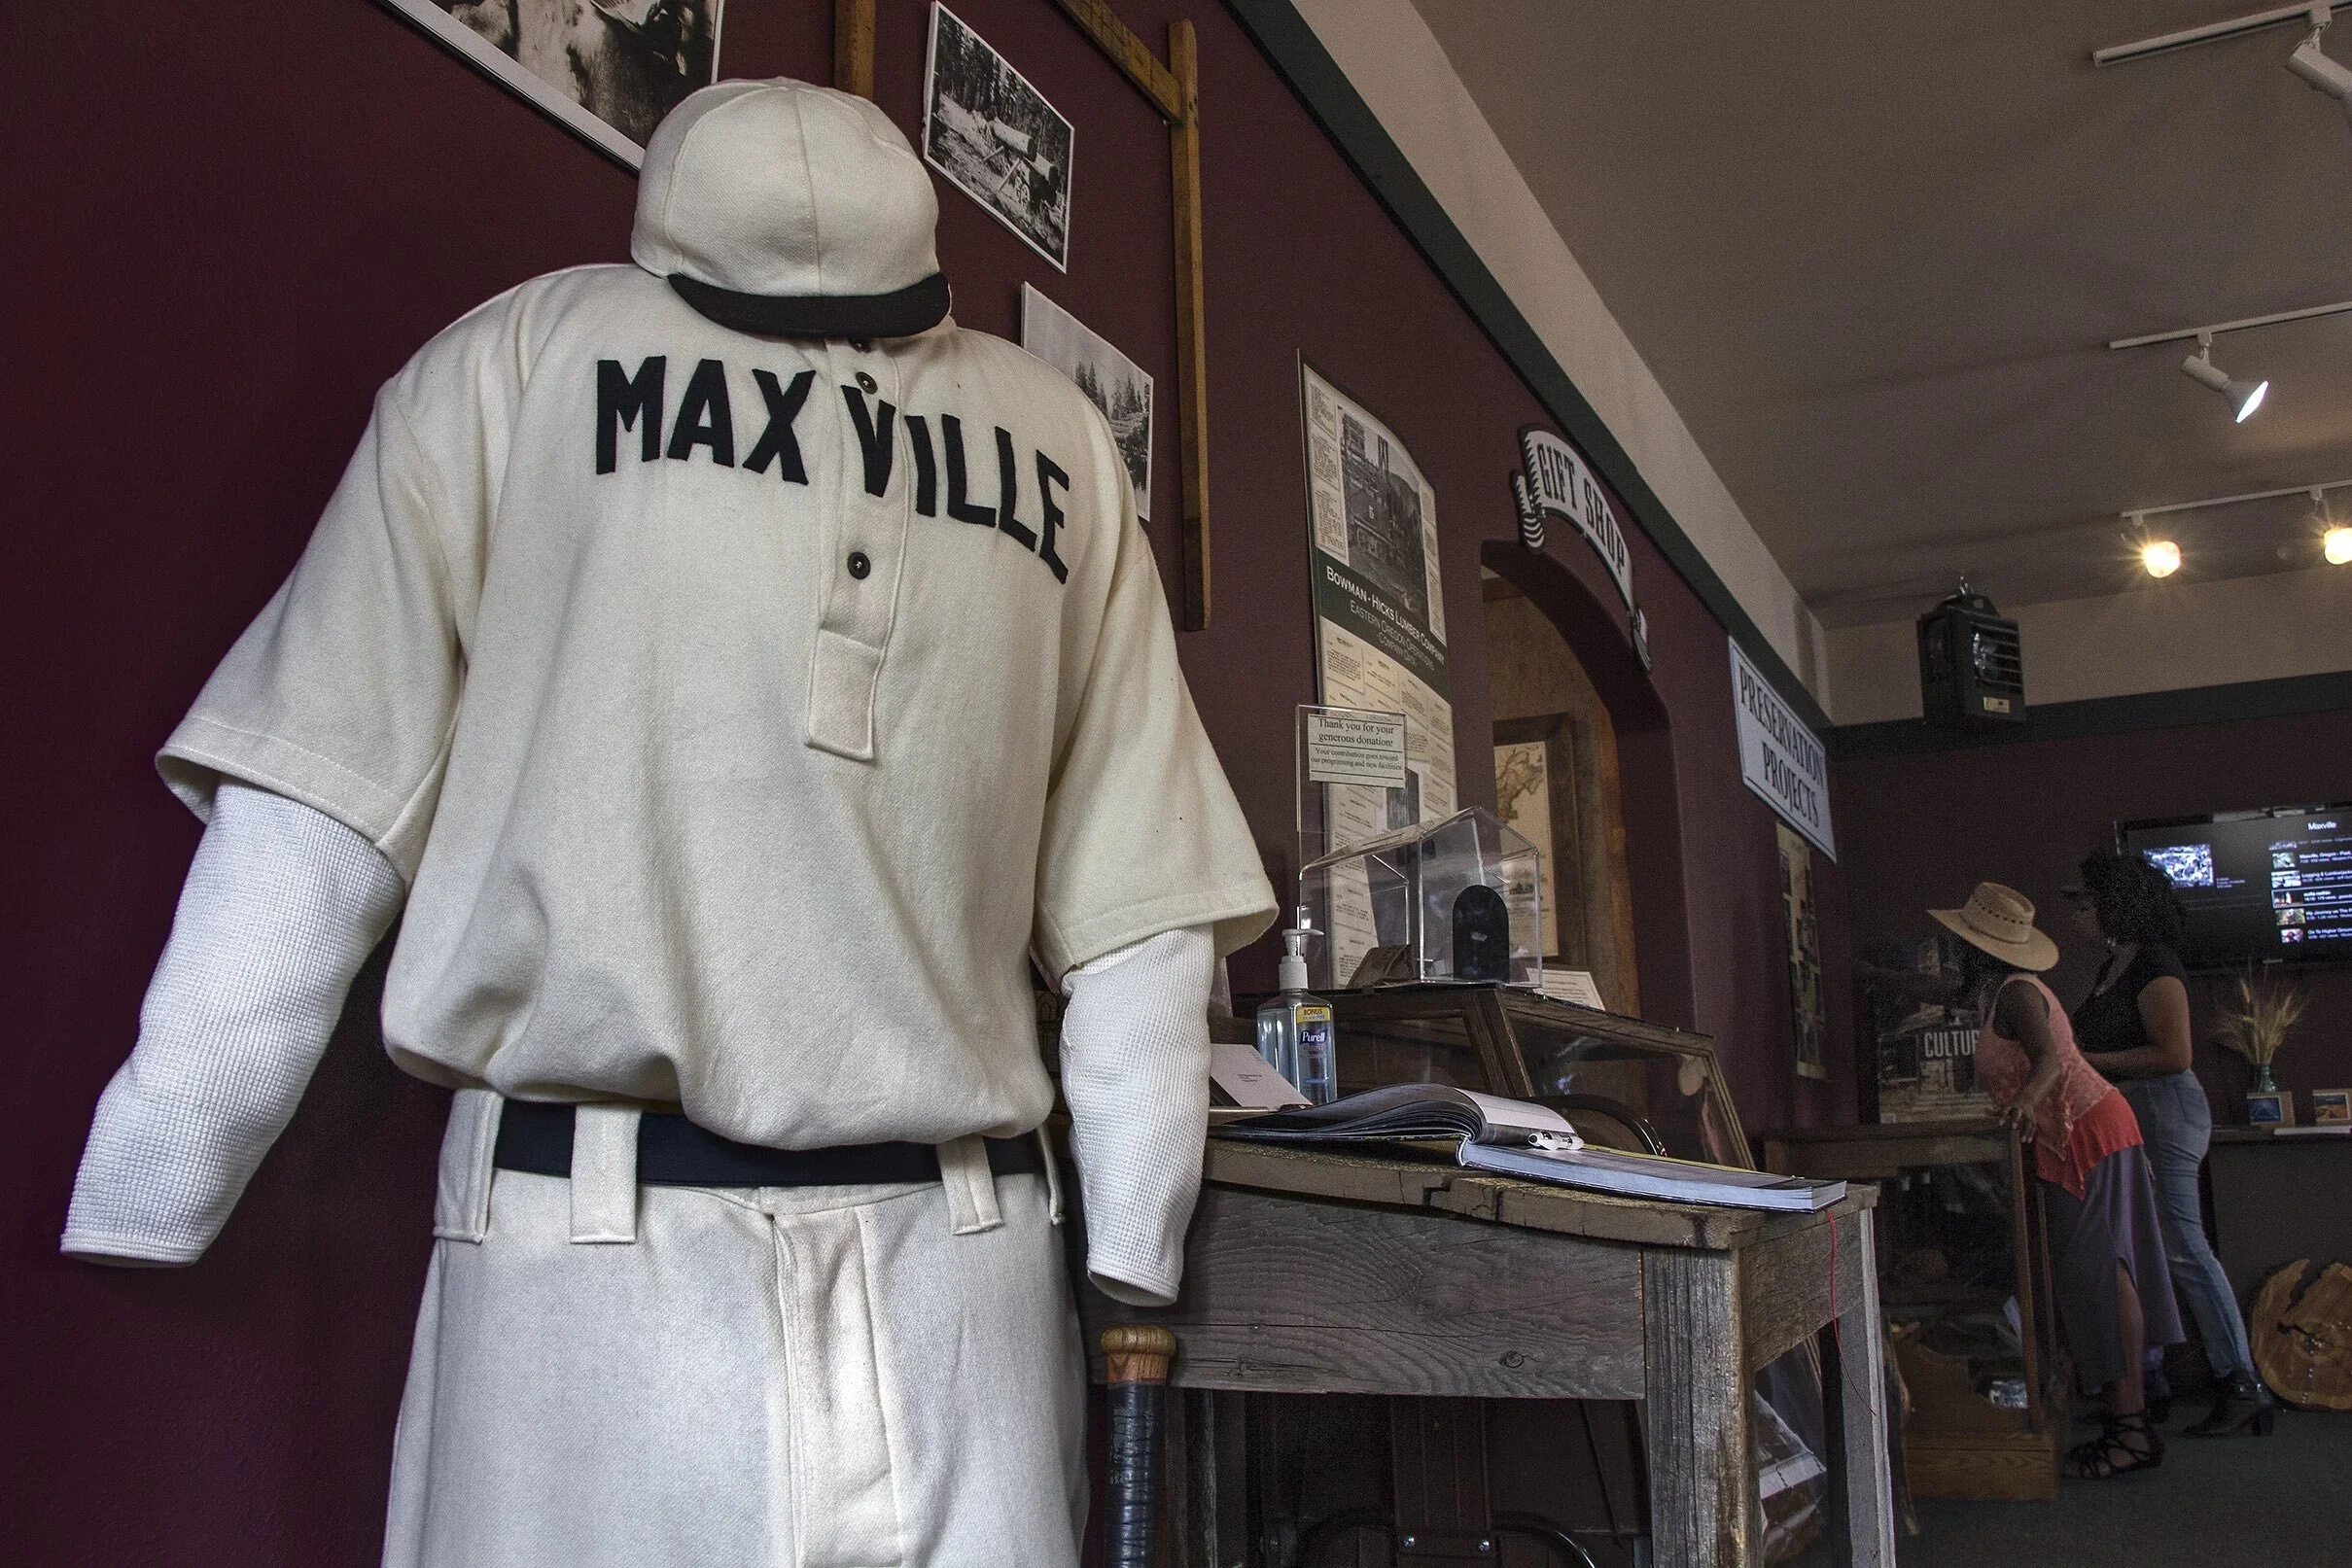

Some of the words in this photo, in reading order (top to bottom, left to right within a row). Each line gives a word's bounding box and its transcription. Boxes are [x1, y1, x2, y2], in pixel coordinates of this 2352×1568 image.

[1537, 442, 1577, 510] GIFT
[1583, 476, 1626, 575] SHOP
[1326, 565, 1367, 602] BOWMAN
[1372, 594, 1395, 621] HICKS
[1395, 610, 1421, 641] LUMBER
[1350, 599, 1381, 629] EASTERN
[1318, 718, 1344, 730] Thank
[1346, 723, 1361, 732] you
[1362, 722, 1374, 732] for
[1376, 726, 1394, 735] your
[1318, 733, 1354, 743] generous
[1738, 664, 1825, 787] PRESERVATION
[1762, 741, 1820, 828] PROJECTS
[1302, 1030, 1325, 1042] Purell
